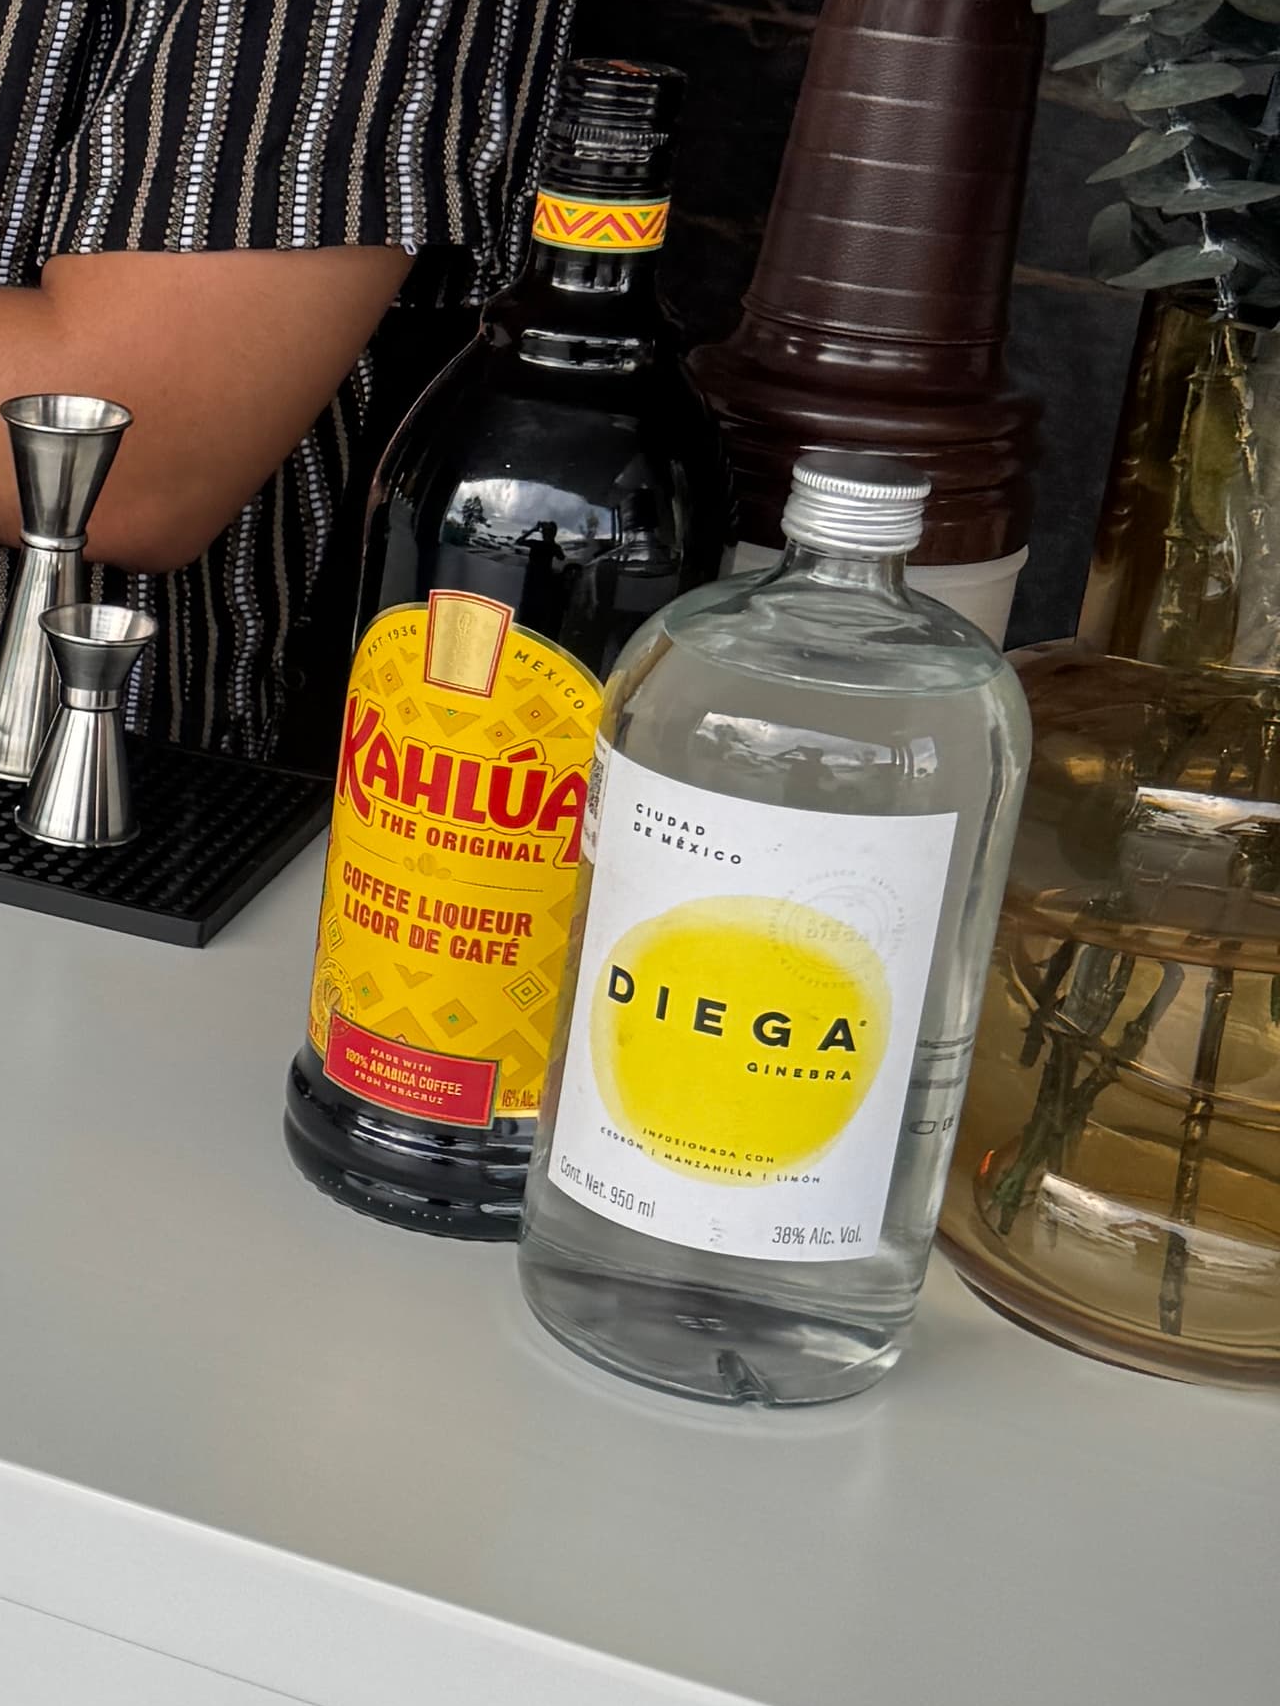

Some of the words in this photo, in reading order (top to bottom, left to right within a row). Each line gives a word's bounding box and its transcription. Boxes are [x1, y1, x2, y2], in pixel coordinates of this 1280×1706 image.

[515, 649, 585, 710] MEXICO
[339, 696, 589, 863] KAHLÚA
[380, 809, 417, 840] THE
[426, 827, 546, 863] ORIGINAL
[635, 802, 706, 836] CIUDAD
[633, 821, 653, 838] DE
[661, 833, 743, 866] MÉXICO
[343, 860, 411, 914] COFFEE
[417, 896, 533, 938] LIQUEUR
[343, 894, 400, 943] LICOR
[408, 924, 441, 955] DE
[449, 938, 520, 967] CAFÉ
[607, 964, 856, 1053] DIEGA
[369, 1047, 400, 1065] MADE
[402, 1058, 432, 1073] WITH
[369, 1061, 416, 1087] ARABICA
[418, 1075, 462, 1097] COFFEE
[746, 1061, 852, 1081] GINEBRA
[354, 1070, 381, 1088] FROM
[383, 1082, 444, 1105] VERACRUZ
[642, 1127, 737, 1160] INFUSIONADA
[745, 1153, 775, 1164] CON
[560, 1154, 583, 1186] Cont.
[584, 1173, 607, 1199] Net.
[610, 1185, 634, 1211] 950
[637, 1199, 656, 1219] ml
[664, 1152, 753, 1178] MANZANILLA
[776, 1172, 821, 1184] LIMÓN
[771, 1225, 806, 1246] 38%
[808, 1227, 835, 1245] Alc.
[840, 1224, 862, 1244] Vol.
